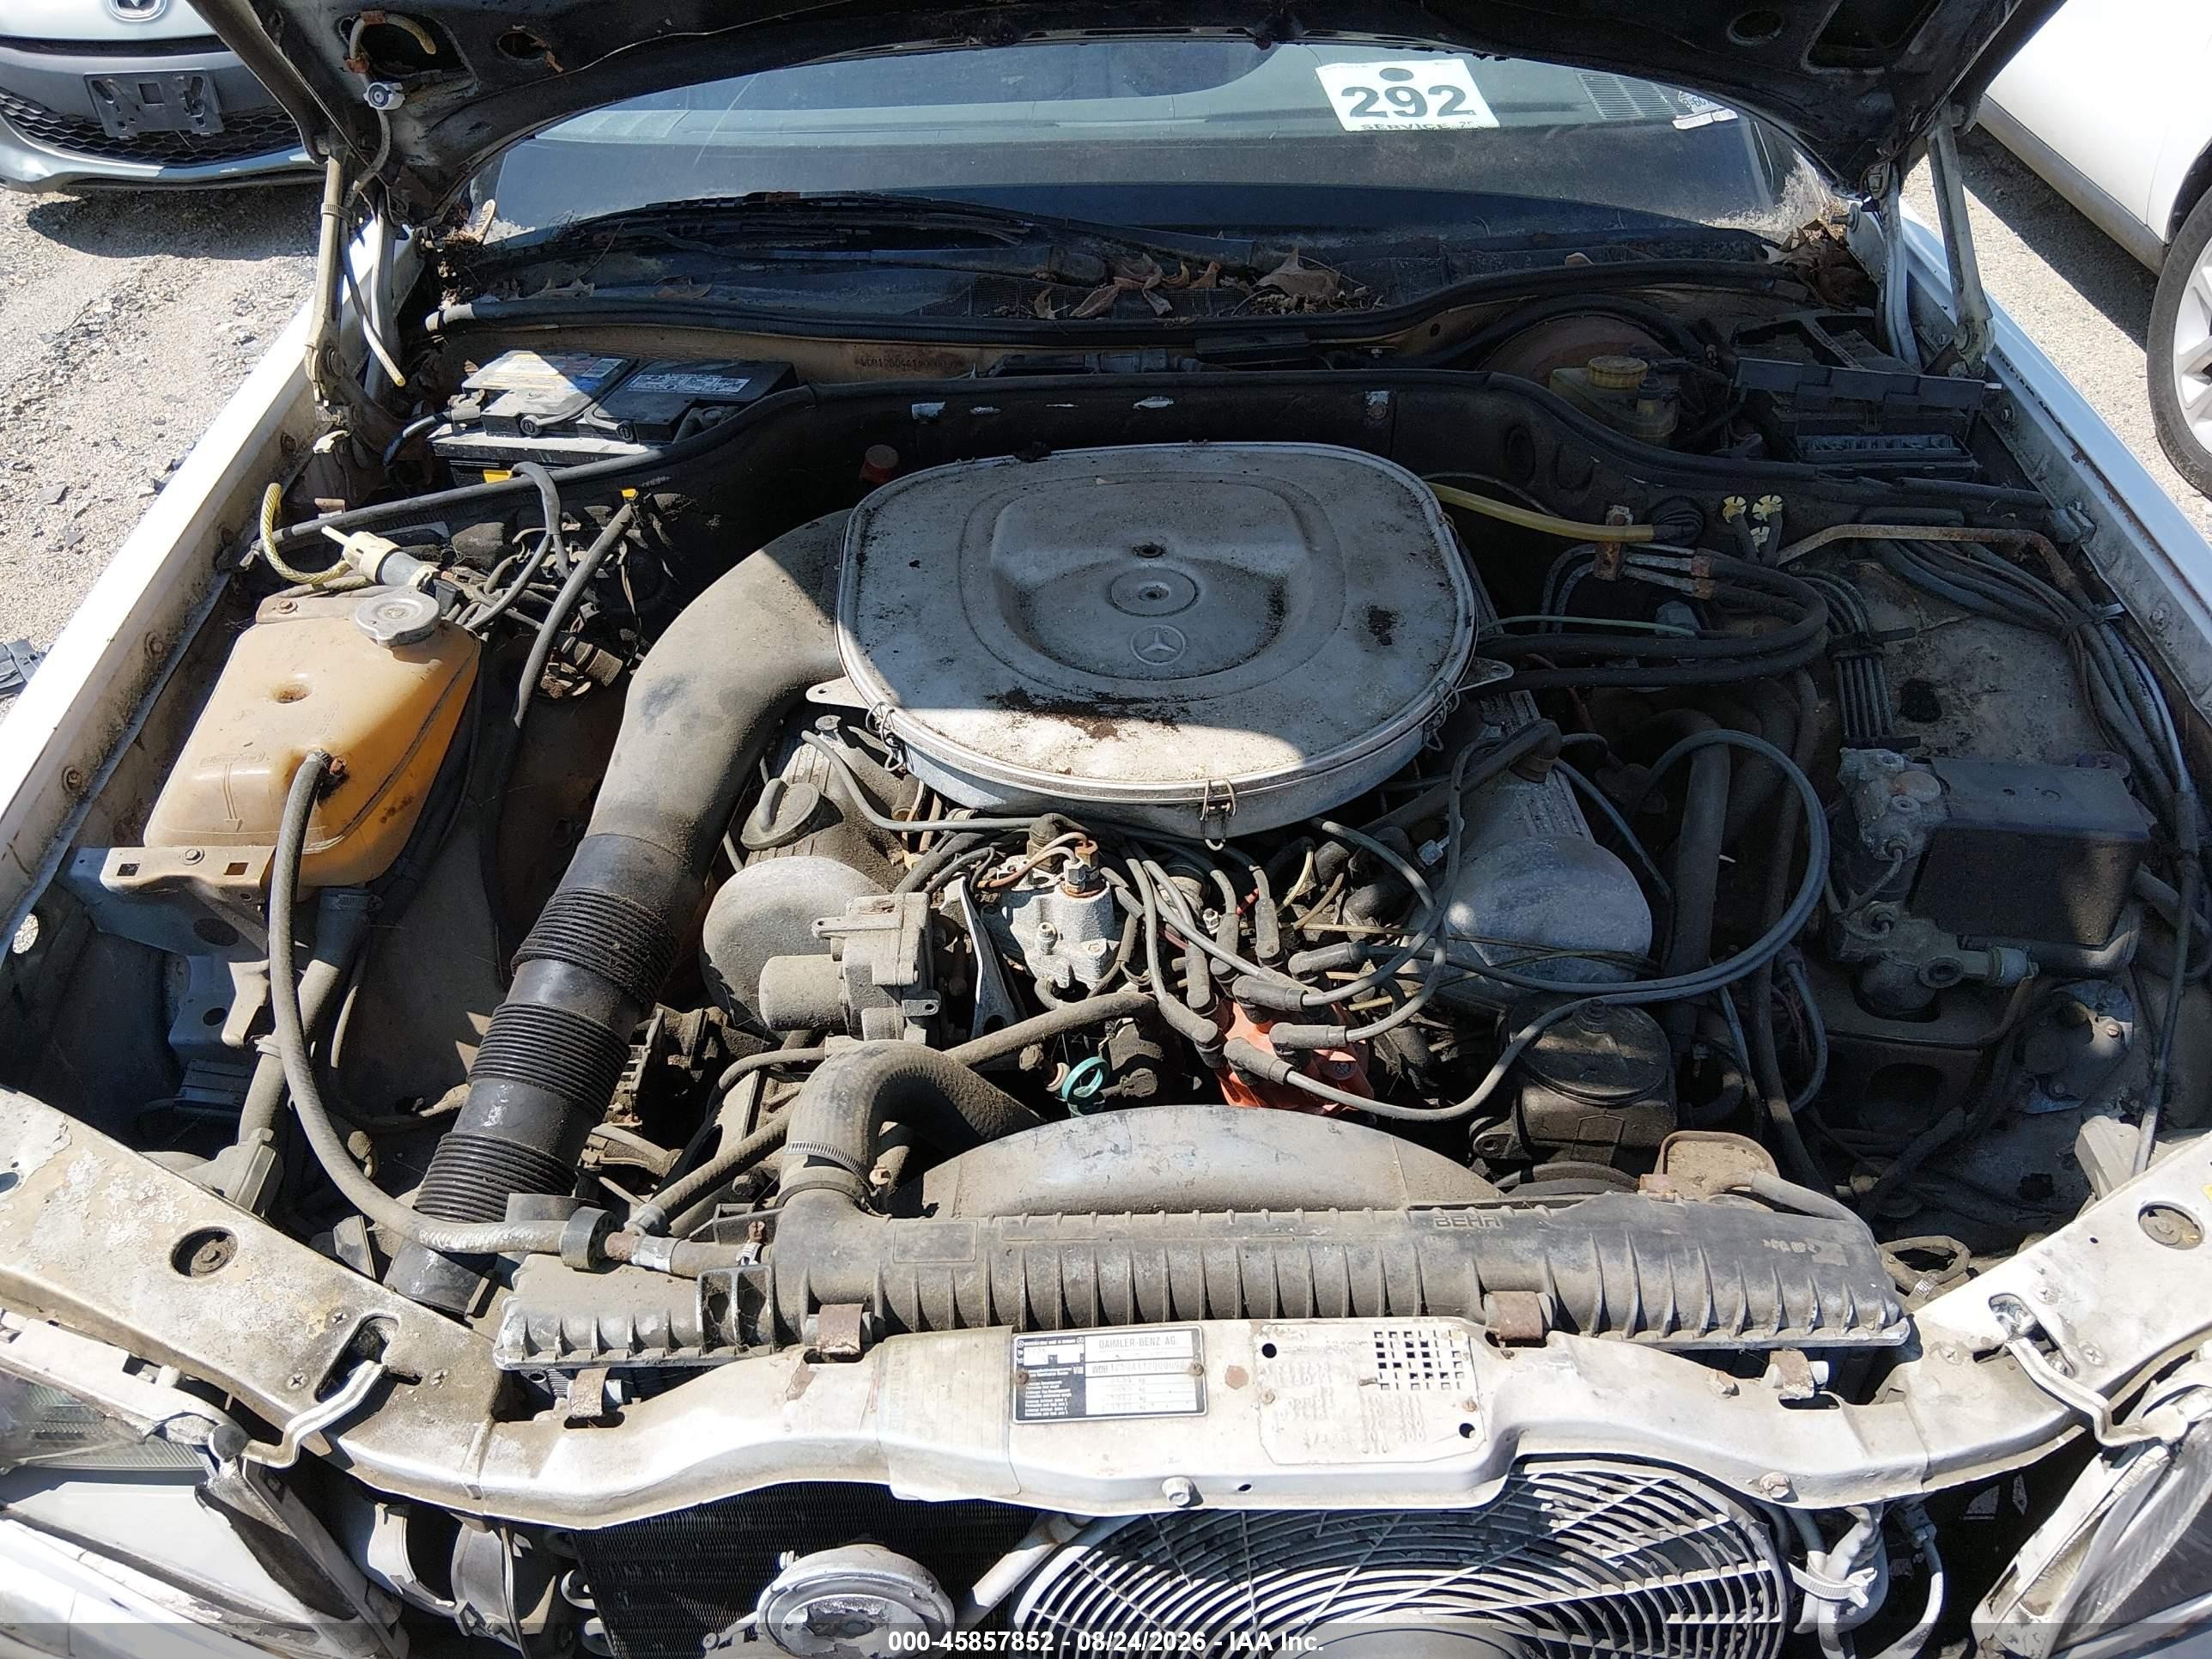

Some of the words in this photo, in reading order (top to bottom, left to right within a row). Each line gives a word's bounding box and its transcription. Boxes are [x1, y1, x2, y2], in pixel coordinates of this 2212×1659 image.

[1341, 84, 1477, 118] 292
[1098, 1336, 1161, 1349] DAIMLER-BENZ
[1164, 1335, 1176, 1346] AG
